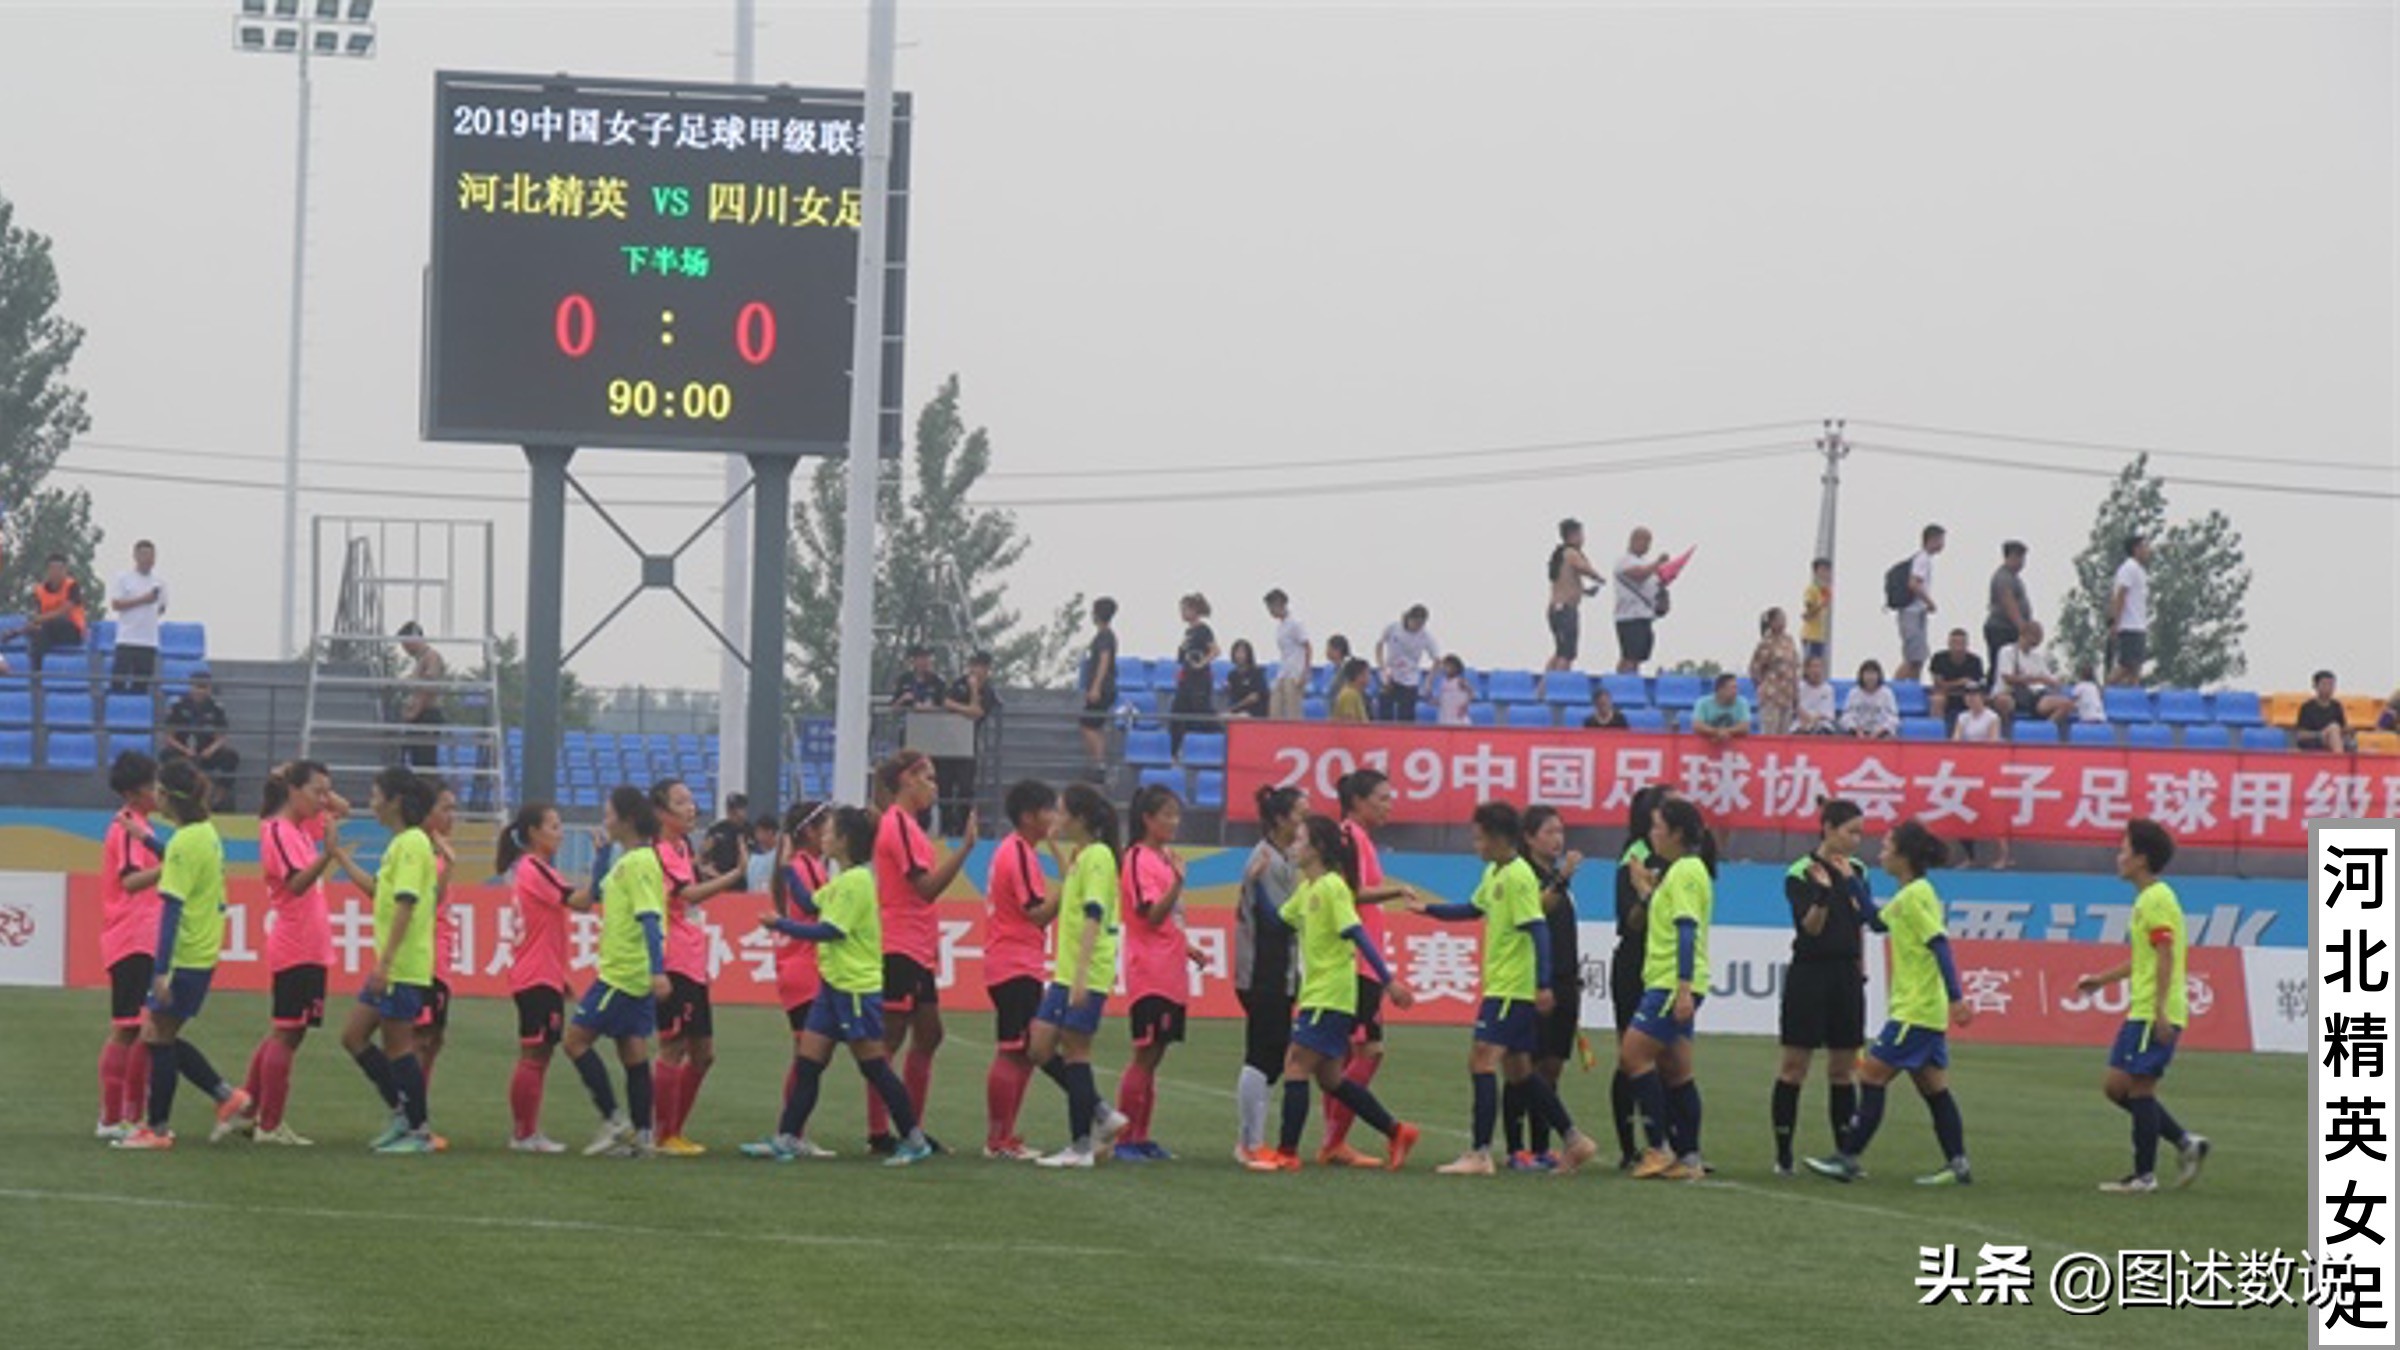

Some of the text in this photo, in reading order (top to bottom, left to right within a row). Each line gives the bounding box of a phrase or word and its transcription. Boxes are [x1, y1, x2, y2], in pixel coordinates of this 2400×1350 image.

[457, 171, 862, 227] 河北精英 VS 四川女足
[620, 246, 710, 277] 下半场
[555, 294, 596, 357] 0
[735, 302, 777, 365] 0
[608, 379, 732, 419] 90:00
[1275, 743, 2400, 835] 2019中国足球协会女子足球甲级
